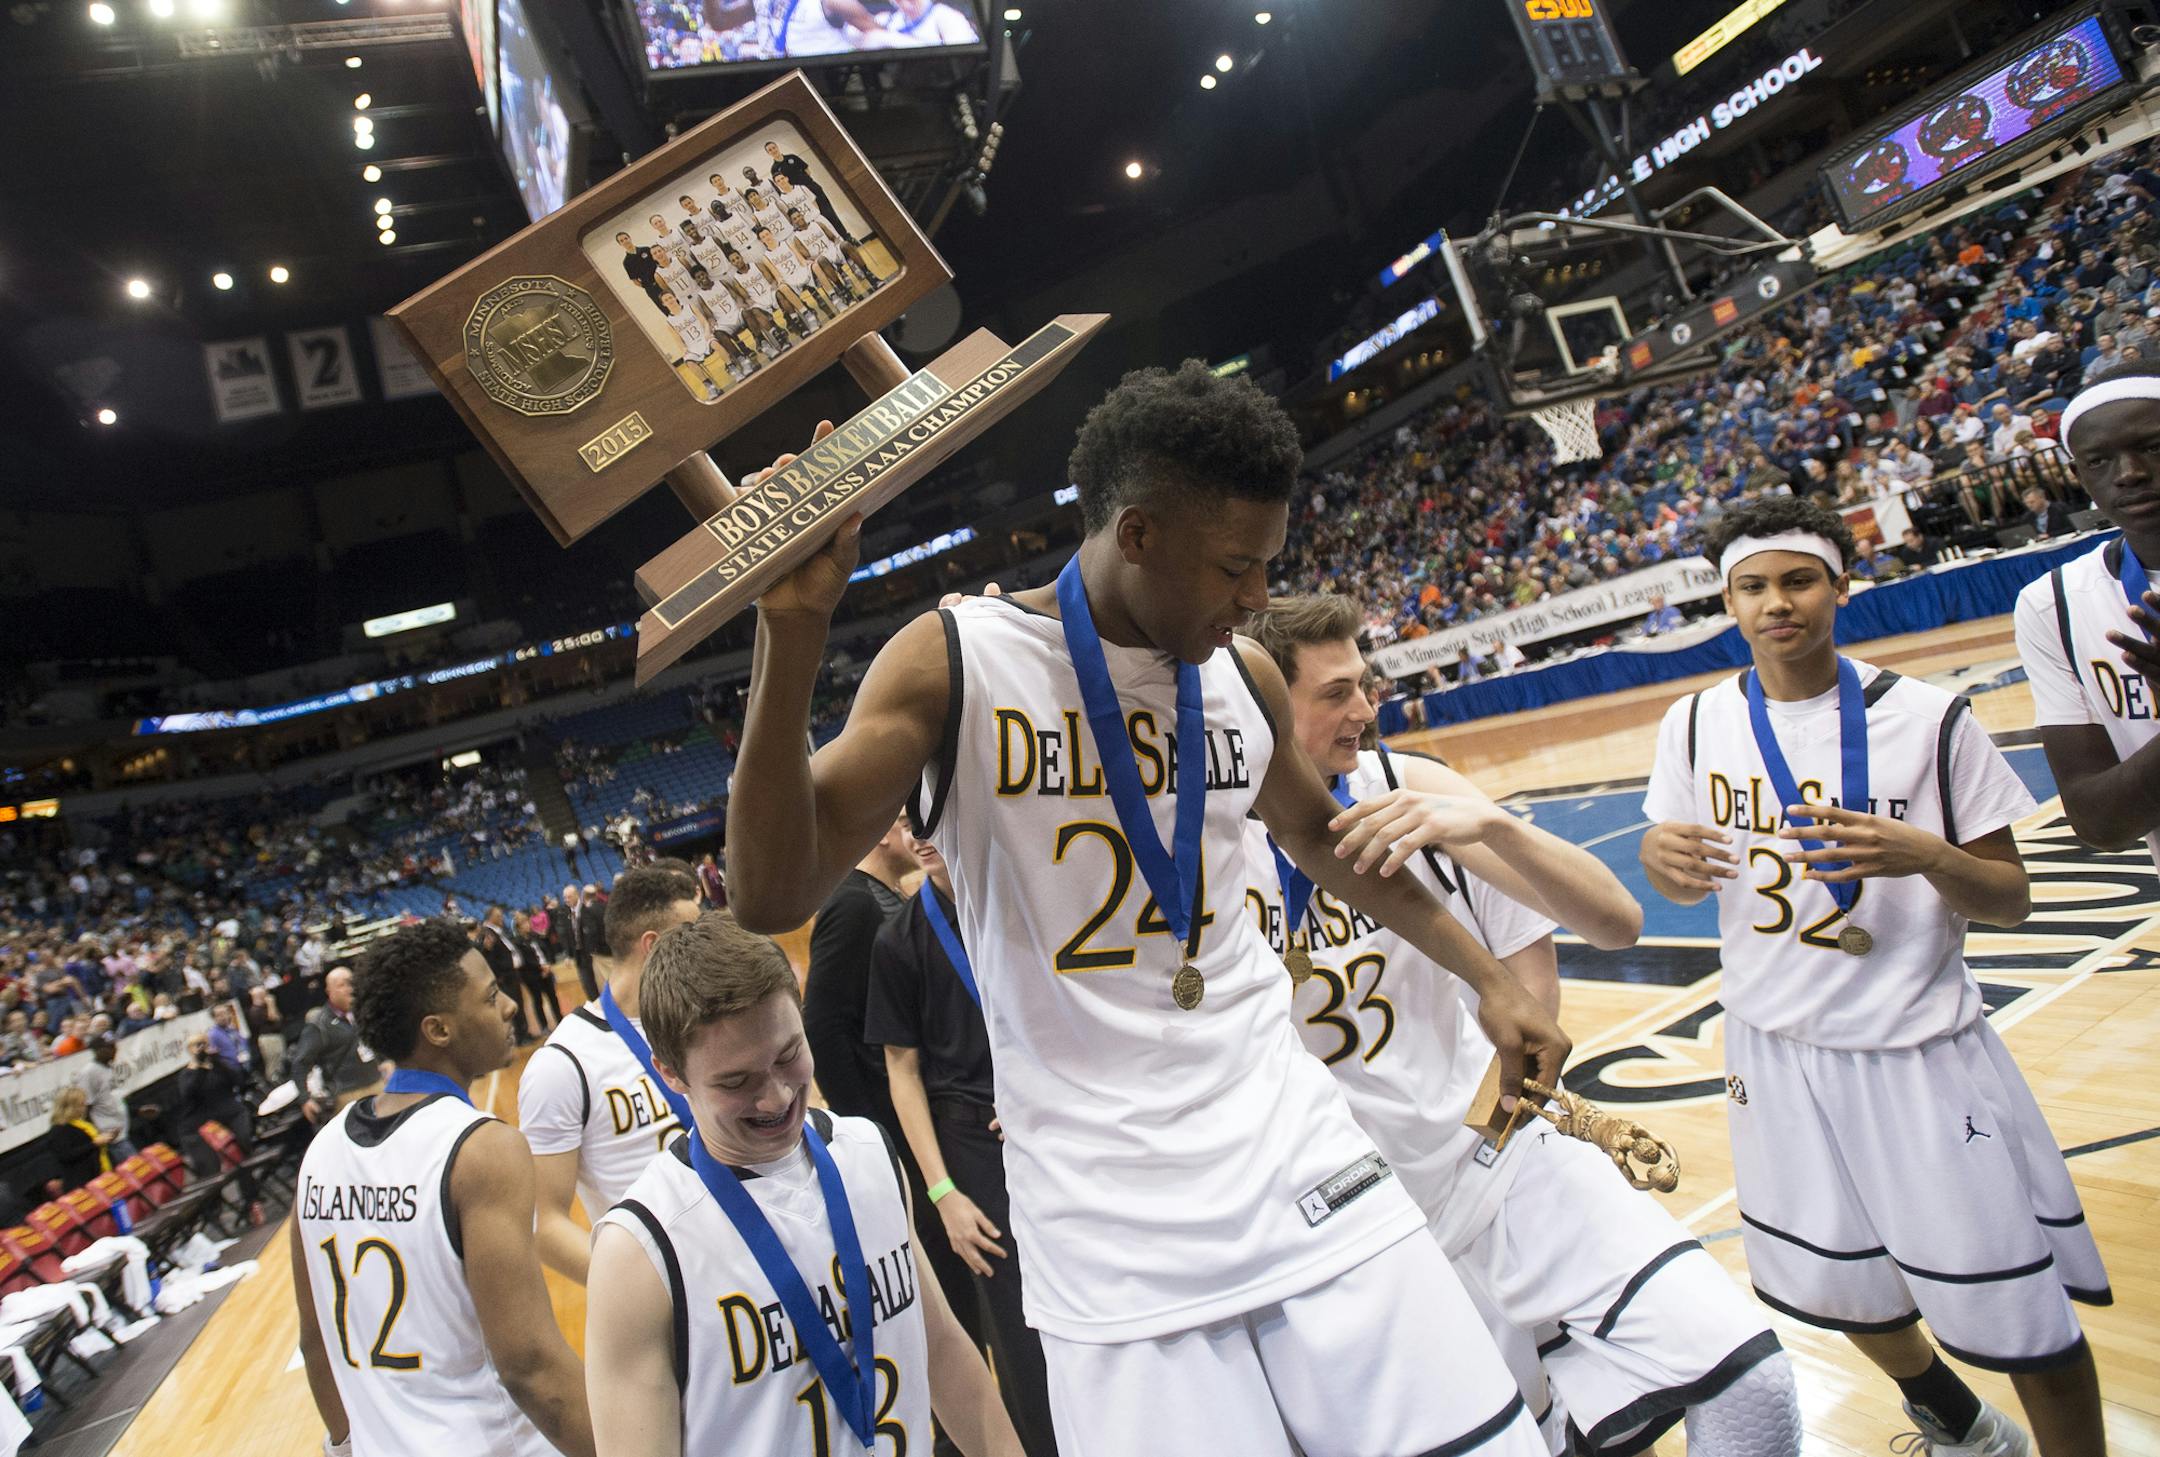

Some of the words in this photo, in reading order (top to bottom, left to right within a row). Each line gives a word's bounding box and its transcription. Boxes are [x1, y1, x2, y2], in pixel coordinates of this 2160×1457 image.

[1652, 116, 1711, 170] HIGH
[1711, 48, 1823, 130] SCHOOL
[471, 280, 556, 337] MINNESOTA
[584, 302, 612, 357] LEAGUE
[477, 369, 518, 405] STATE
[520, 399, 563, 412] HIGH
[566, 361, 610, 406] SCHOOL
[586, 419, 645, 467] 2015
[711, 480, 794, 547] BOYS
[782, 376, 947, 497] BASKETBALL
[717, 522, 795, 582] STATE
[791, 470, 866, 527] CLASS
[863, 437, 914, 483] AAA
[907, 357, 1024, 443] CHAMPION
[1471, 625, 1508, 648] State
[1509, 611, 1549, 643] High
[1550, 600, 1606, 626] School
[1053, 819, 1216, 975] 24
[1749, 848, 1864, 950] 32
[1293, 952, 1396, 1066] 33
[303, 1175, 418, 1222] ISLANDERS
[1325, 1160, 1374, 1199] JORDAN
[320, 1233, 423, 1371] 12
[796, 1354, 908, 1457] 13
